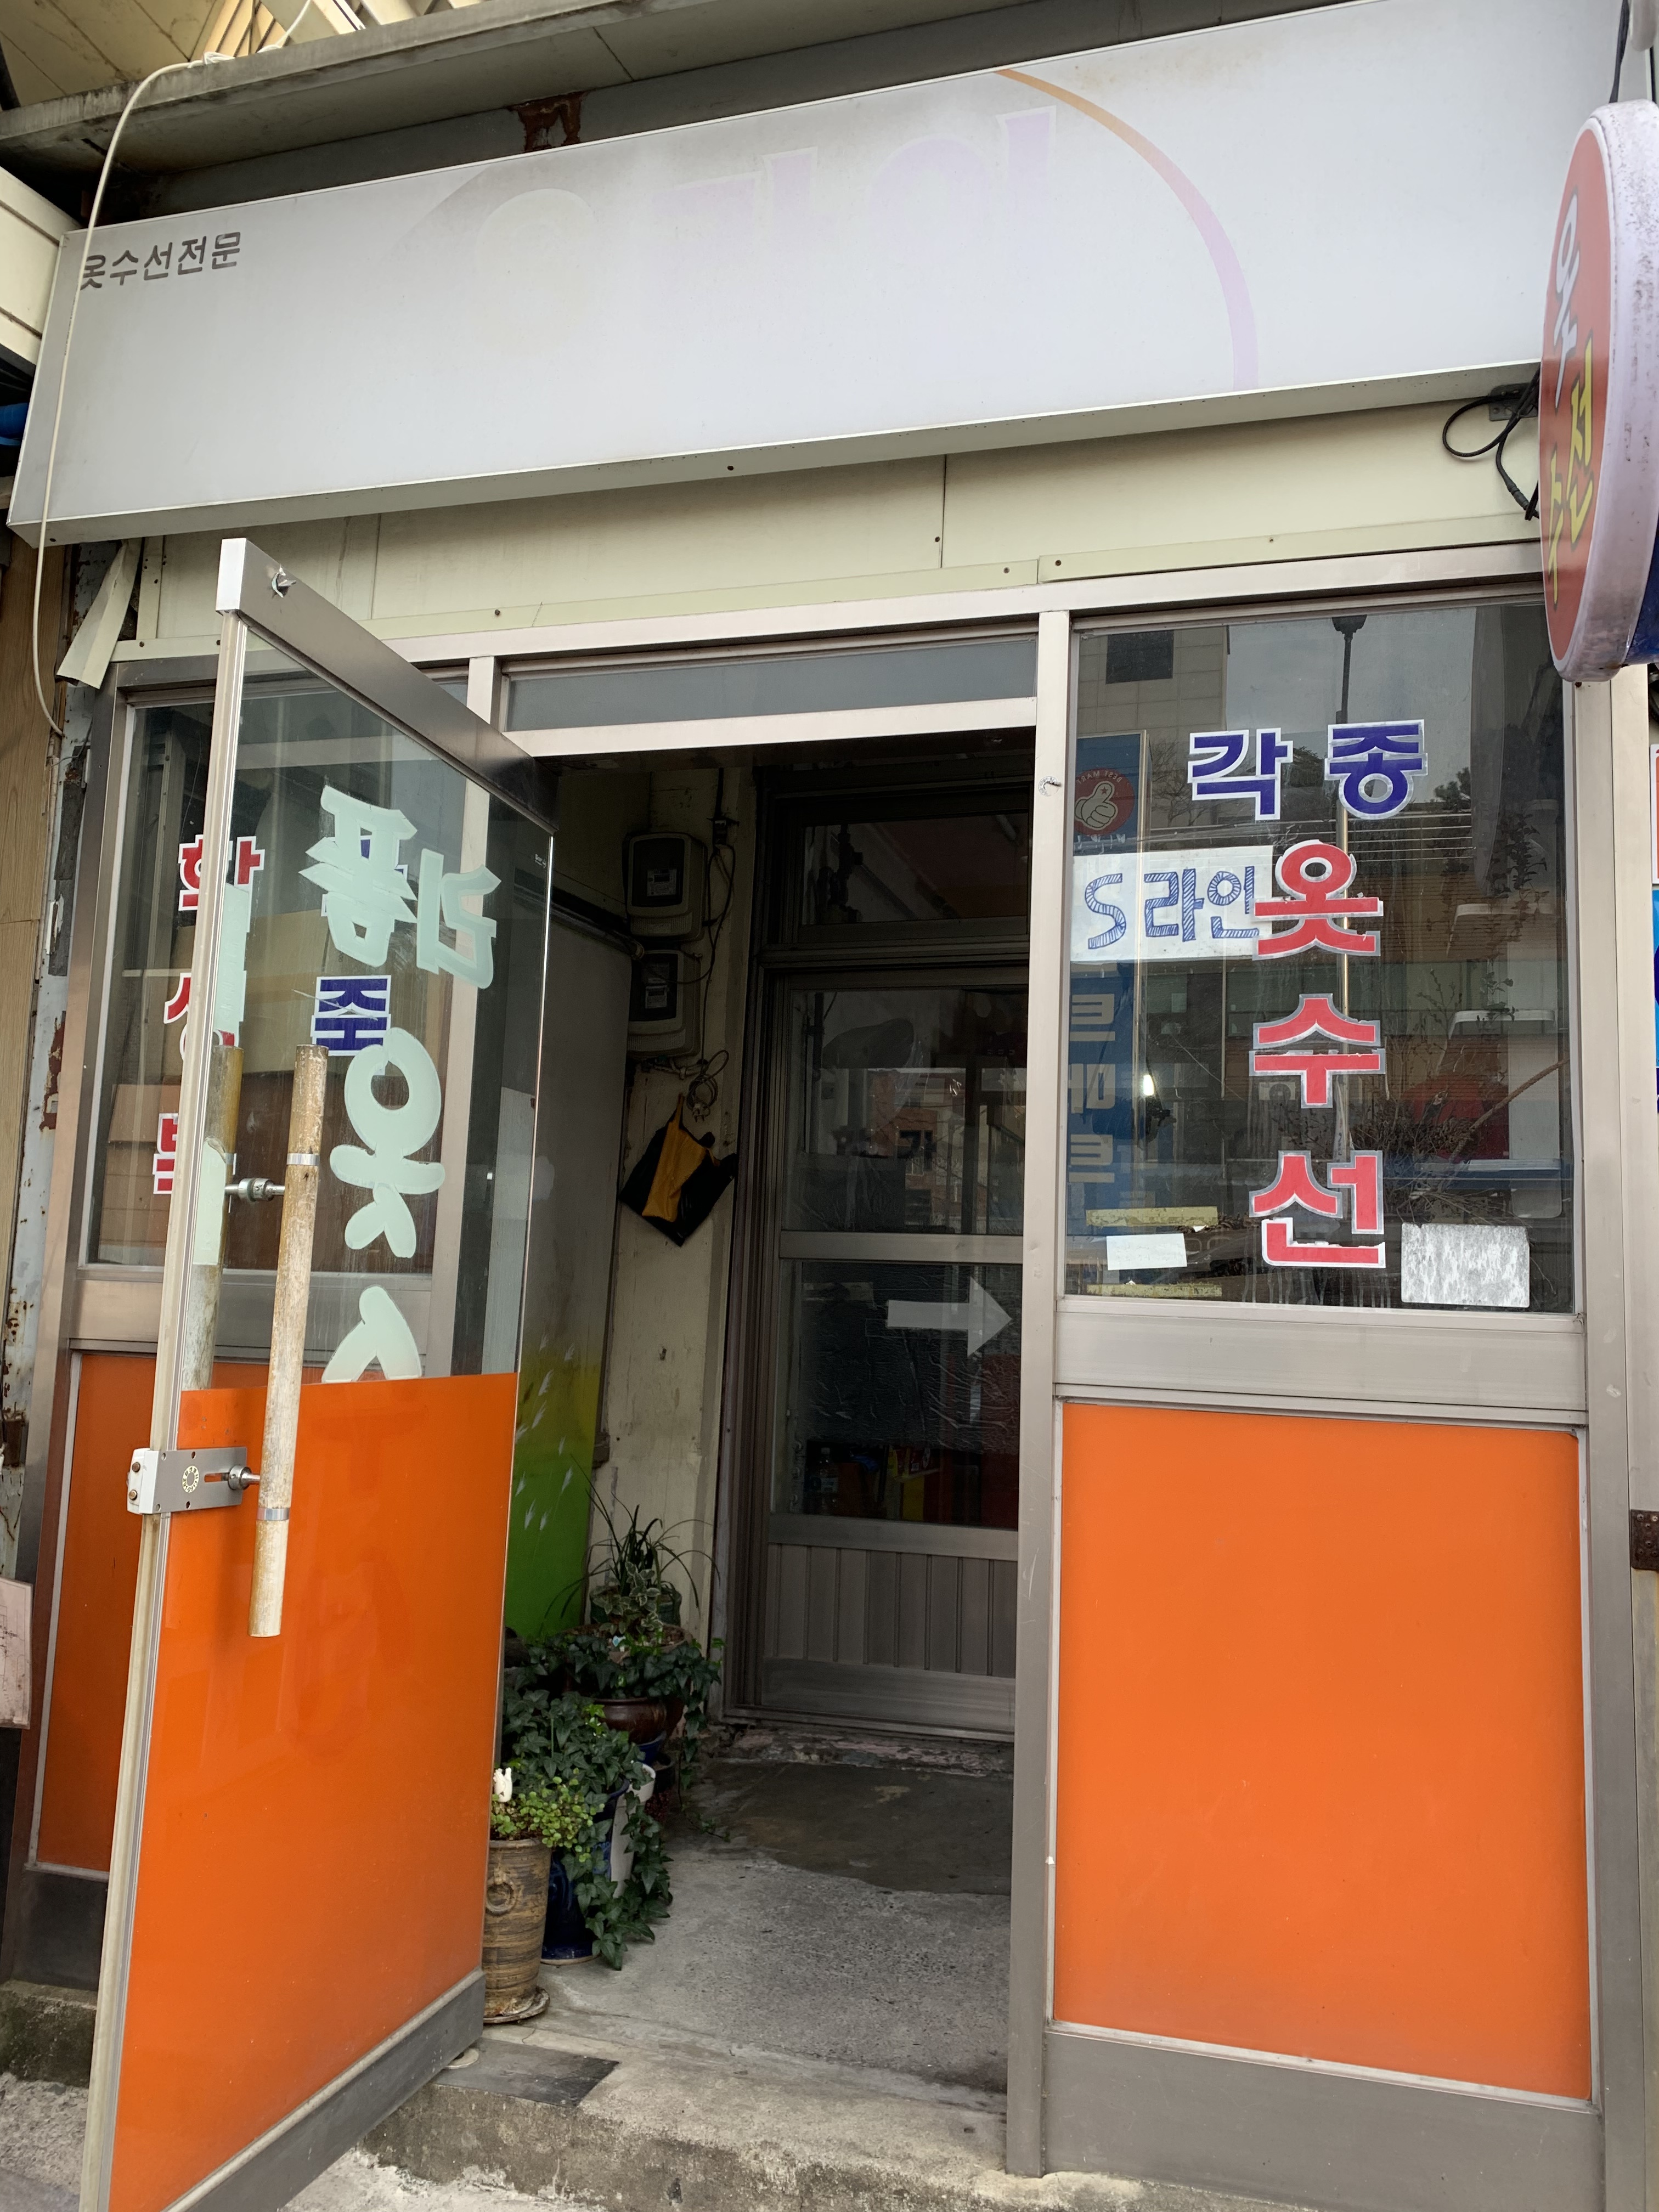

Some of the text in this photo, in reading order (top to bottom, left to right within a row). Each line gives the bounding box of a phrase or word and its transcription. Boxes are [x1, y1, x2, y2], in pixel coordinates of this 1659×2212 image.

[81, 232, 241, 291] 옷수선전문
[1188, 721, 1429, 820] 각종
[1085, 865, 1261, 950] S라인
[1252, 840, 1386, 1268] 옷수선
